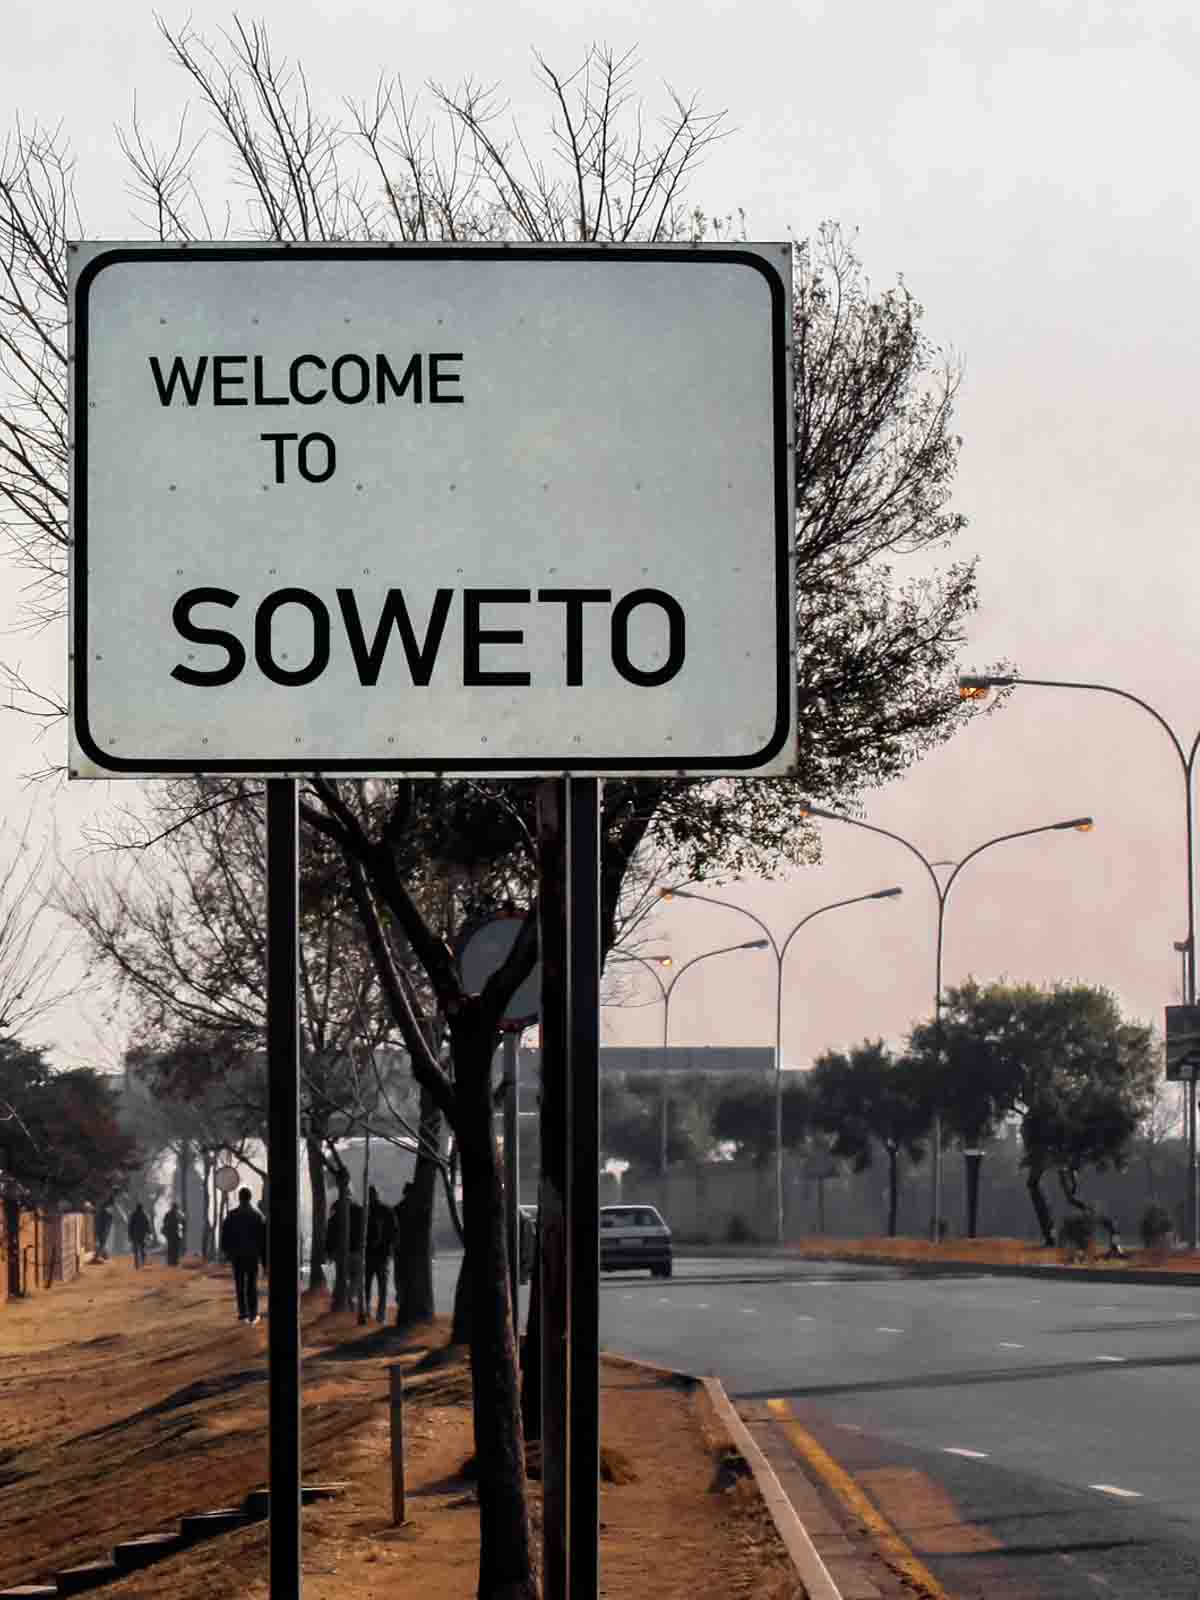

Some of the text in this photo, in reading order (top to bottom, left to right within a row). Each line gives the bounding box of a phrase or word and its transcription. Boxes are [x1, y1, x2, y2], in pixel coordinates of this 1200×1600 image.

[148, 352, 465, 407] WELCOME
[260, 431, 337, 484] TO
[169, 586, 686, 688] SOWETO
